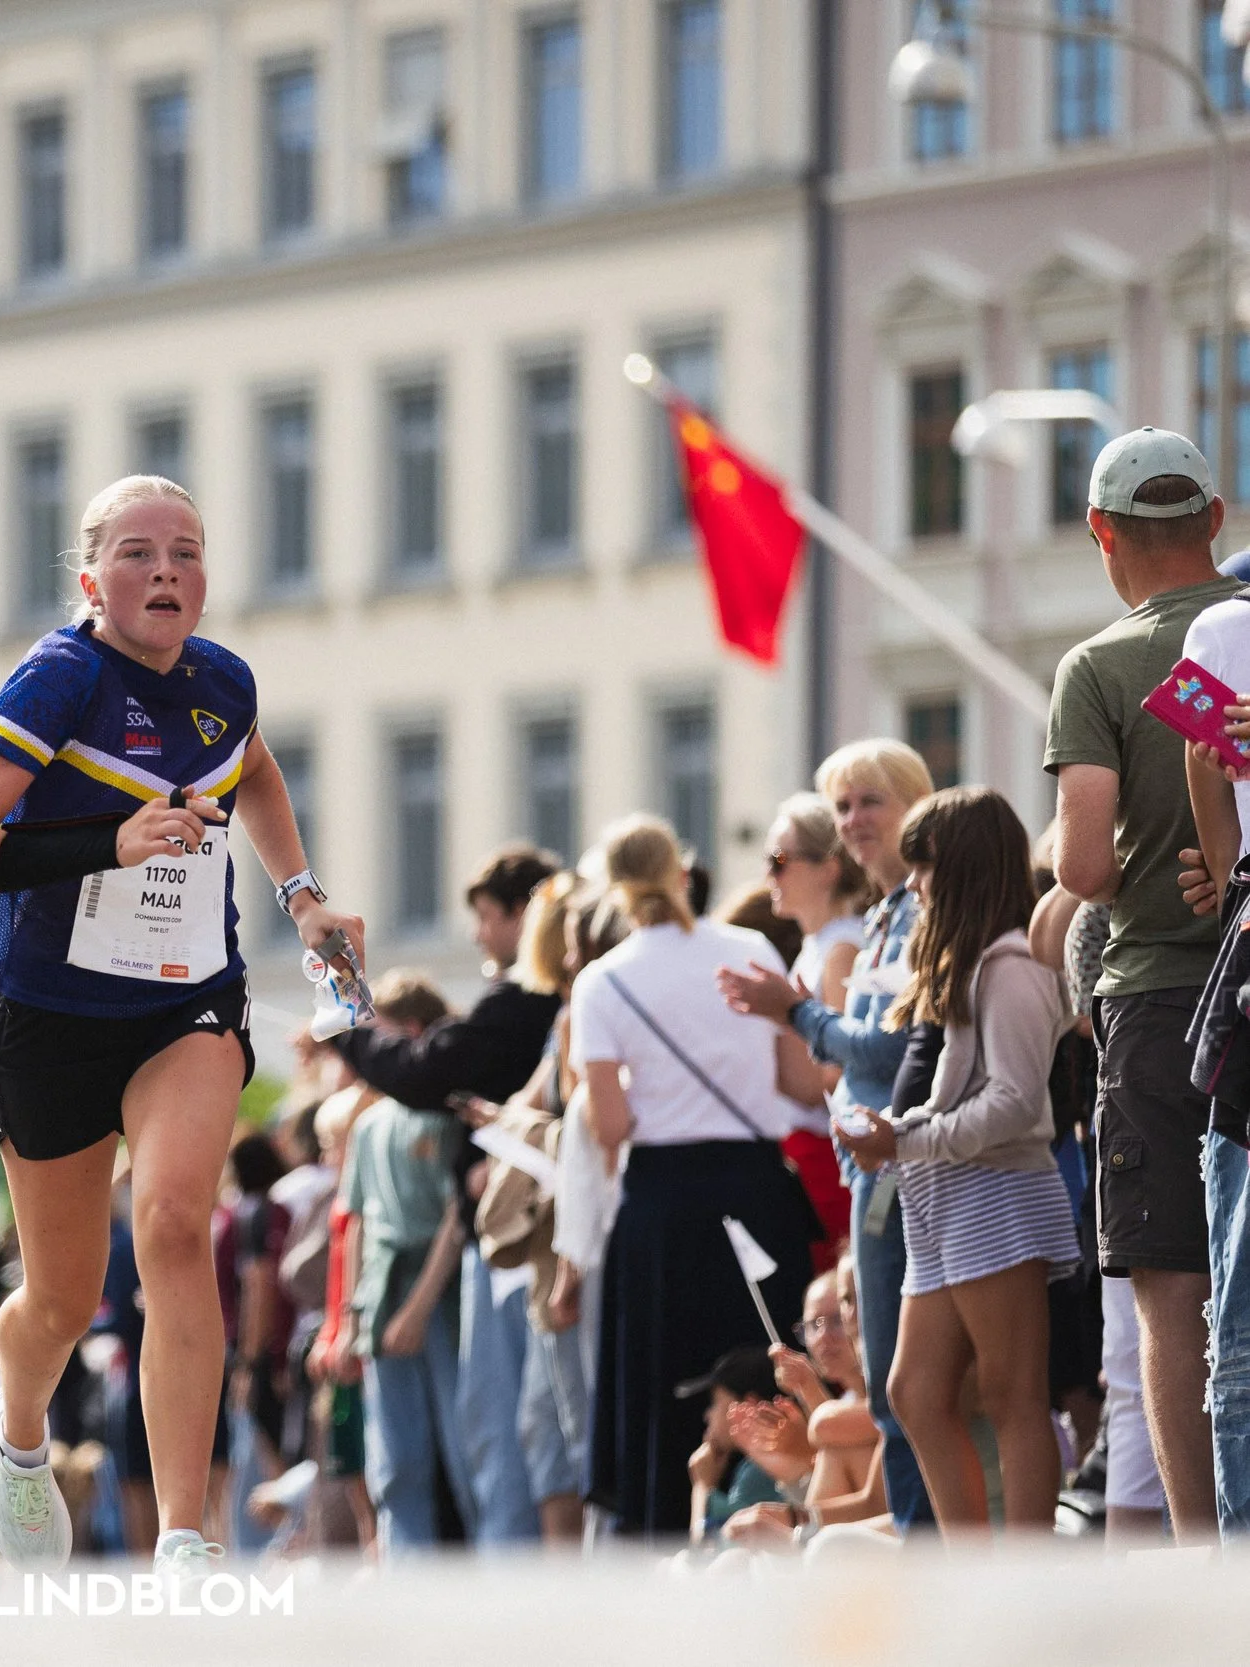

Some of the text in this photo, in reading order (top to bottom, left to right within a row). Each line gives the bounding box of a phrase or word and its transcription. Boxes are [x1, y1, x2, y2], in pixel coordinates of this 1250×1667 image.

[145, 866, 187, 885] 11700
[140, 891, 181, 910] MAJA
[110, 957, 154, 971] CHALMERS
